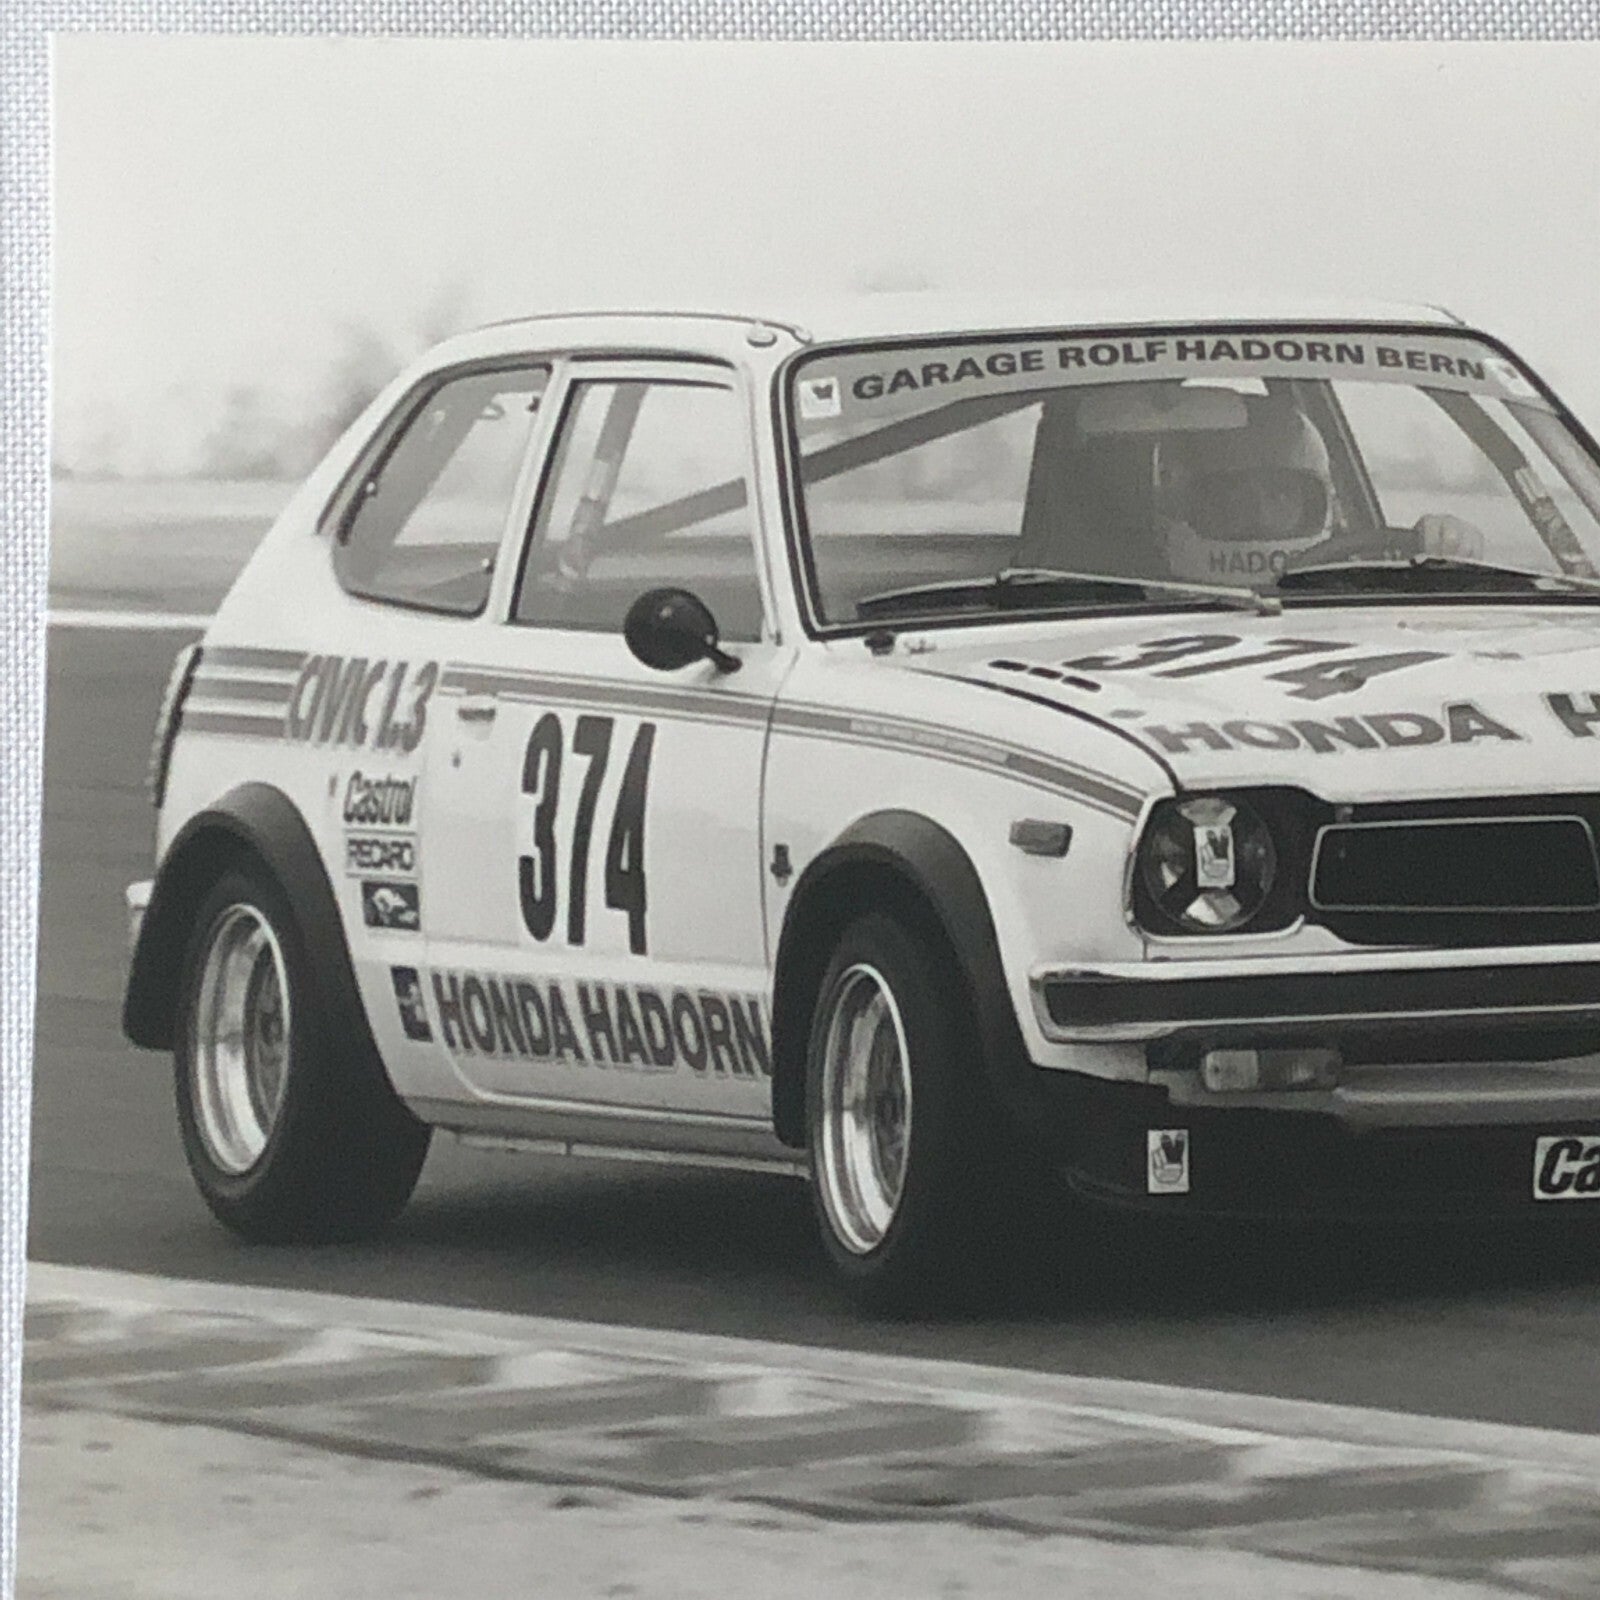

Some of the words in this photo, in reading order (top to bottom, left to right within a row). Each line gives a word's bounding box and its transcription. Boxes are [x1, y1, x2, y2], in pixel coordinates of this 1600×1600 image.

[852, 349, 1045, 399] GARAGE
[1058, 341, 1168, 369] ROLF
[1175, 340, 1365, 364] HADORN
[1376, 347, 1487, 381] BERN
[289, 654, 388, 746] CIVIC
[1062, 634, 1452, 700] 374
[1142, 703, 1524, 754] HONDA
[343, 769, 418, 825] Castrol
[518, 711, 657, 956] 374
[431, 971, 585, 1061] HONDA
[577, 981, 773, 1077] HADORN
